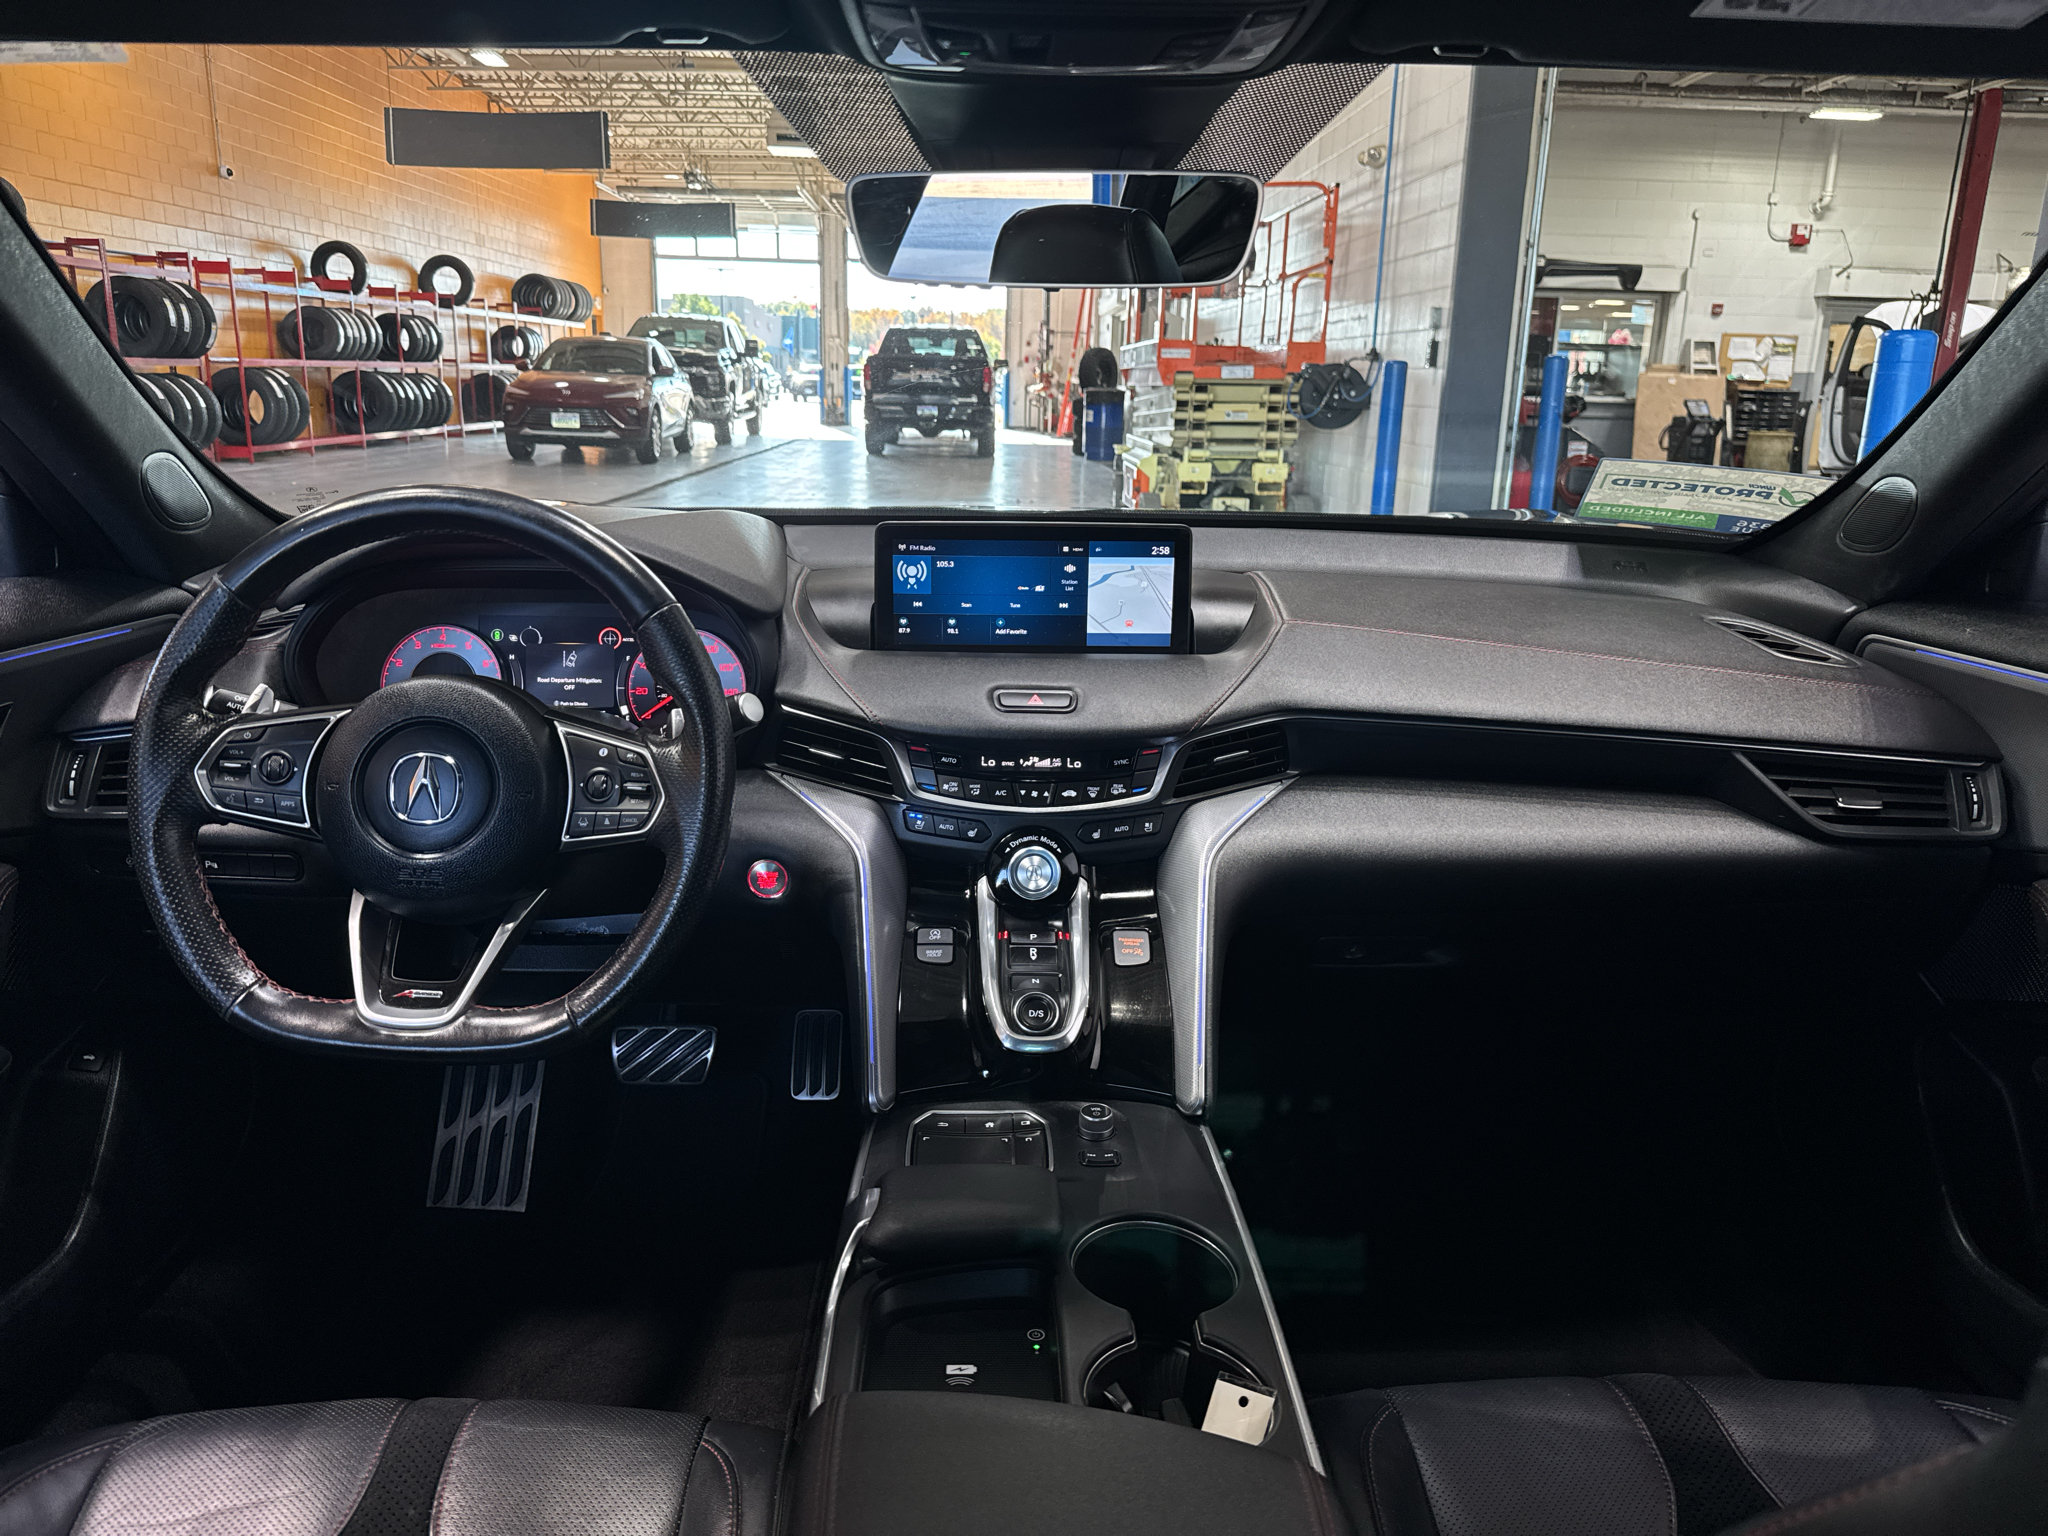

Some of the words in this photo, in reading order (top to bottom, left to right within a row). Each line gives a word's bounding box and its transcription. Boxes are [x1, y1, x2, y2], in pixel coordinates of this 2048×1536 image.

[1151, 546, 1170, 555] 2:58
[439, 633, 446, 641] 4
[415, 641, 421, 649] 3
[464, 641, 472, 650] 5
[395, 659, 403, 667] 2
[635, 687, 648, 695] 20
[941, 756, 957, 764] AUTO
[981, 755, 996, 767] Lo
[1067, 757, 1081, 768] Lo
[939, 823, 954, 831] AUTO
[1009, 835, 1039, 848] Dynamic
[1040, 835, 1058, 849] Mode
[1029, 947, 1037, 955] R
[1028, 1009, 1045, 1017] D/S
